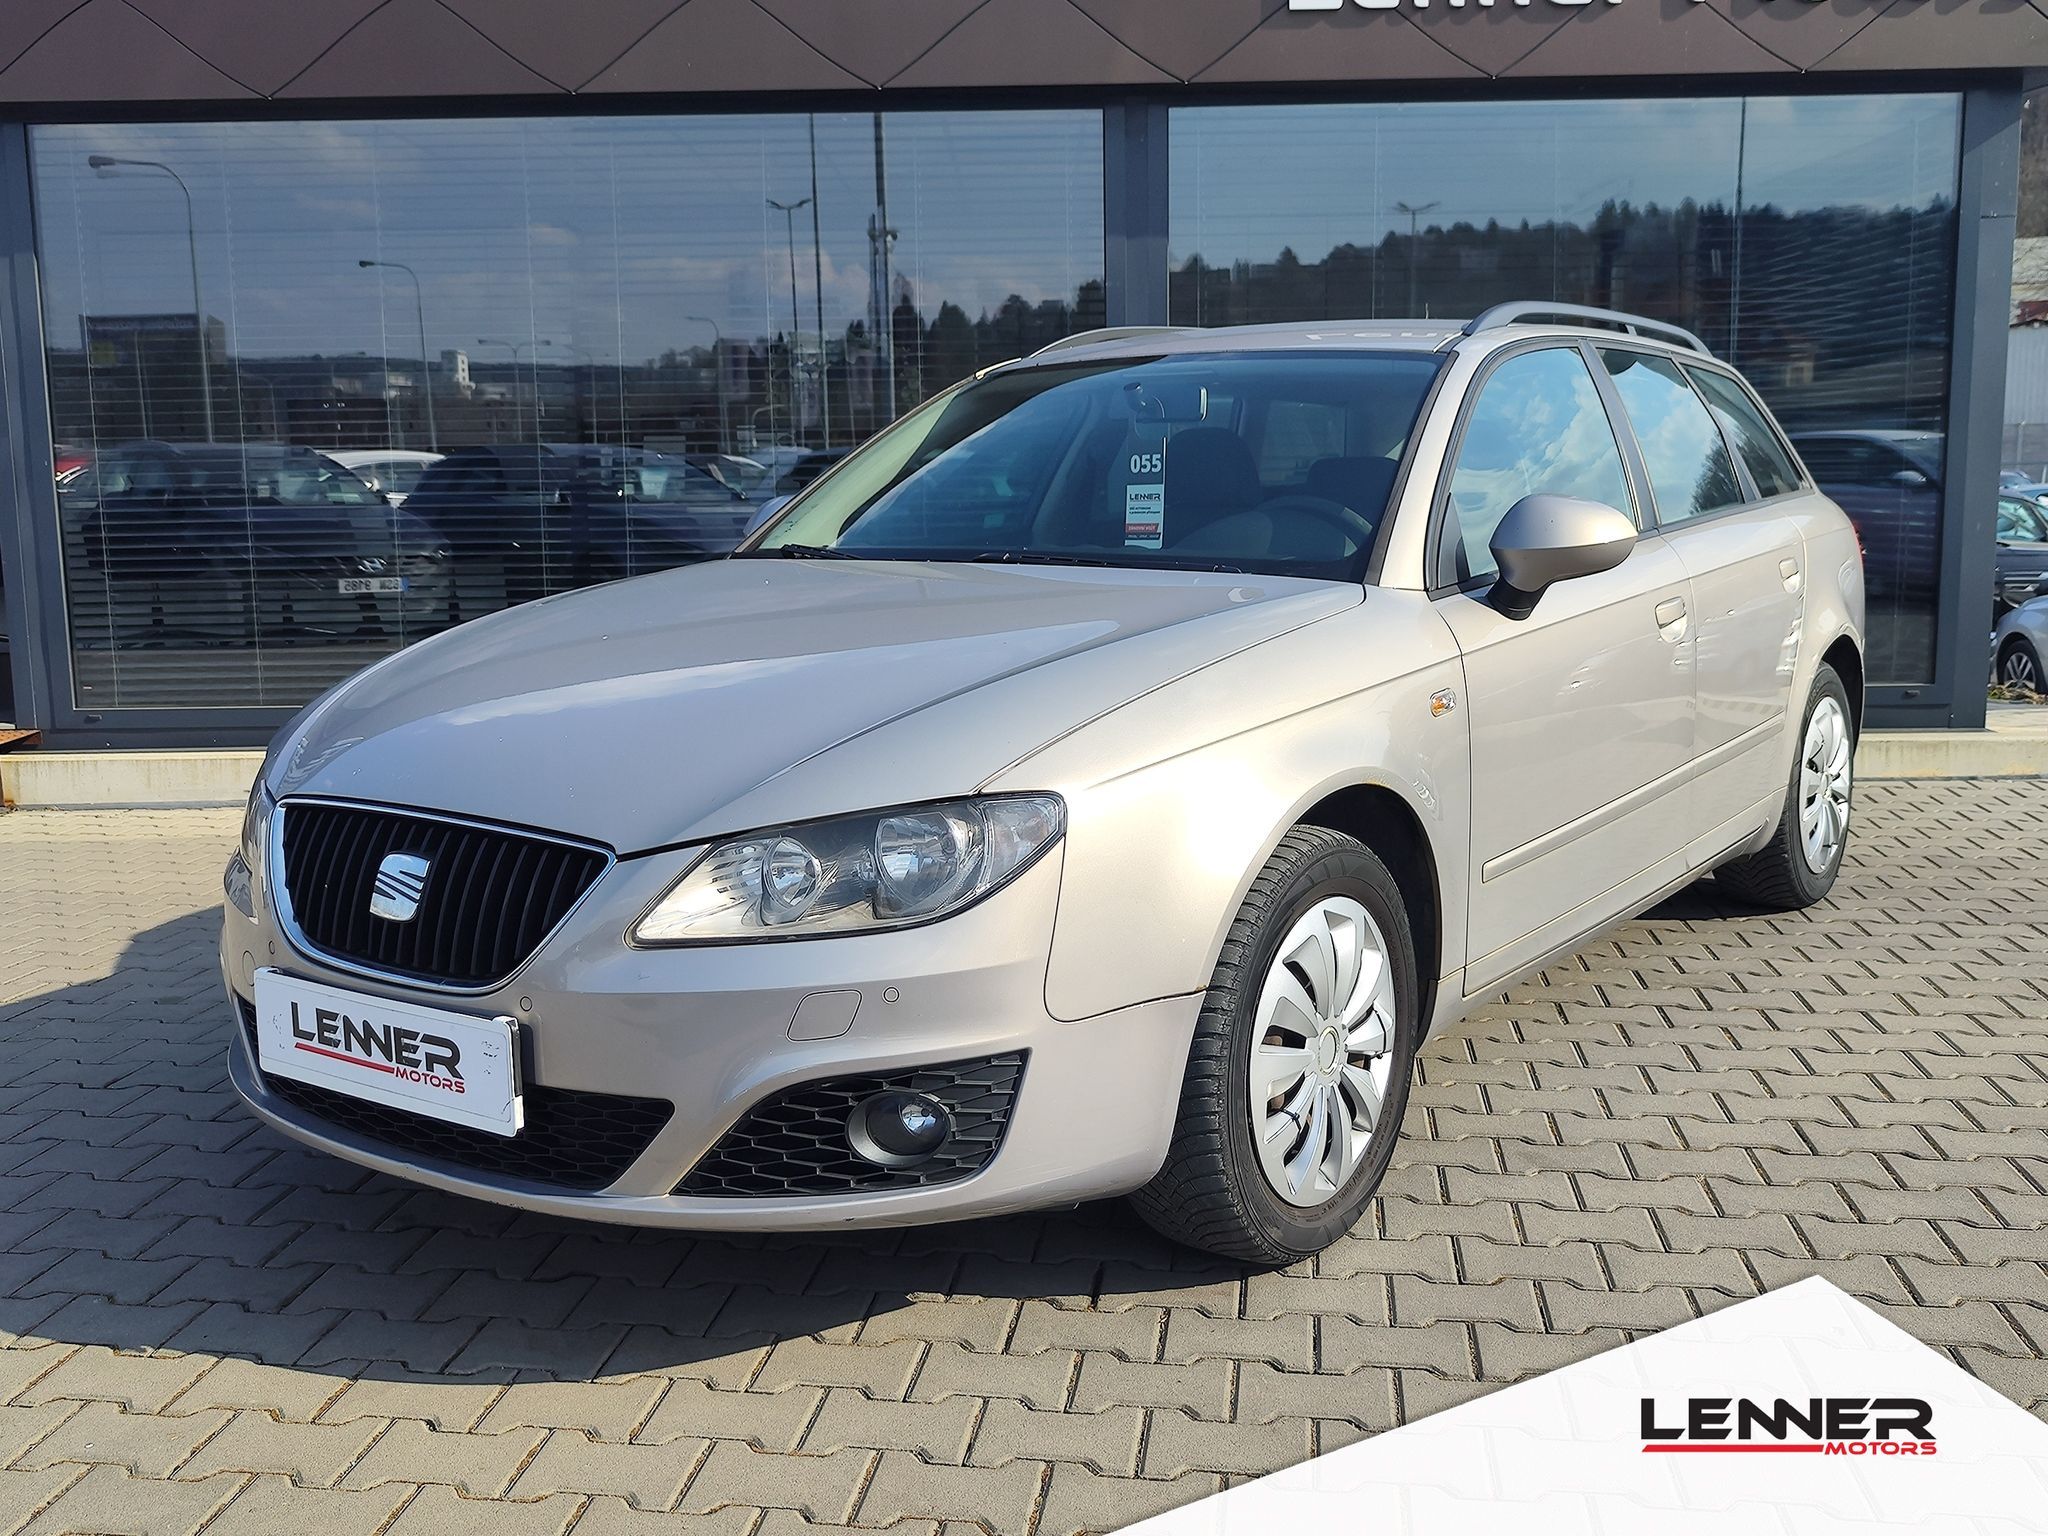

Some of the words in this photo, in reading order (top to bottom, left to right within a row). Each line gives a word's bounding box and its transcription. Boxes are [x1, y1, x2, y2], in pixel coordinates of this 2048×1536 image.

[1130, 454, 1162, 474] 055
[1129, 493, 1161, 501] LENNER
[291, 1001, 464, 1080] LENNER
[395, 1066, 466, 1094] MOTORS
